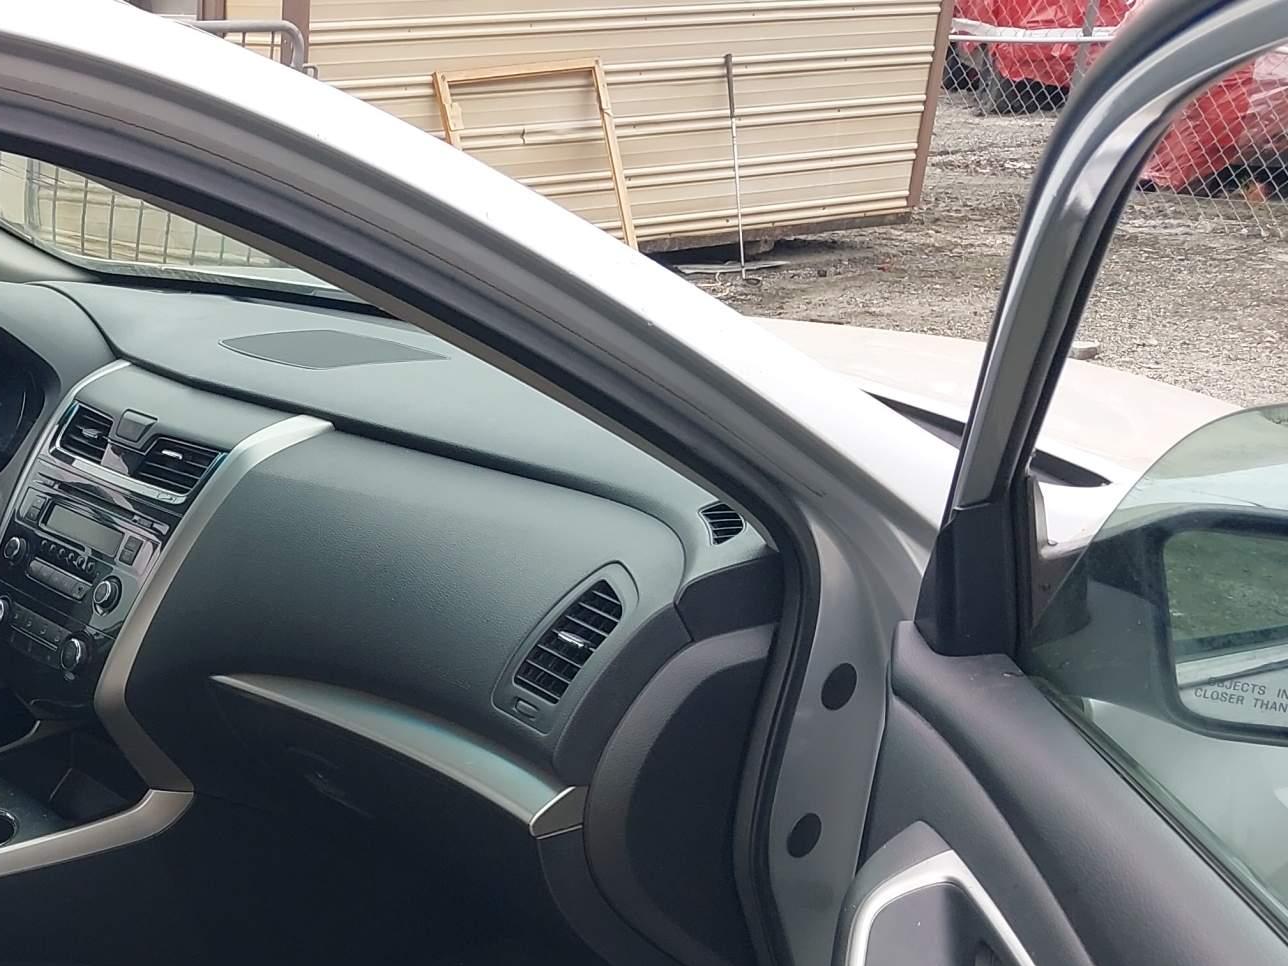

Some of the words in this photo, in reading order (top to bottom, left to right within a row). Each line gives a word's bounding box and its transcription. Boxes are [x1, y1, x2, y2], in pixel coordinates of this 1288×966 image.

[1207, 677, 1266, 695] OBJECTS
[1194, 687, 1245, 704] CLOSER
[1253, 698, 1288, 712] THAN
